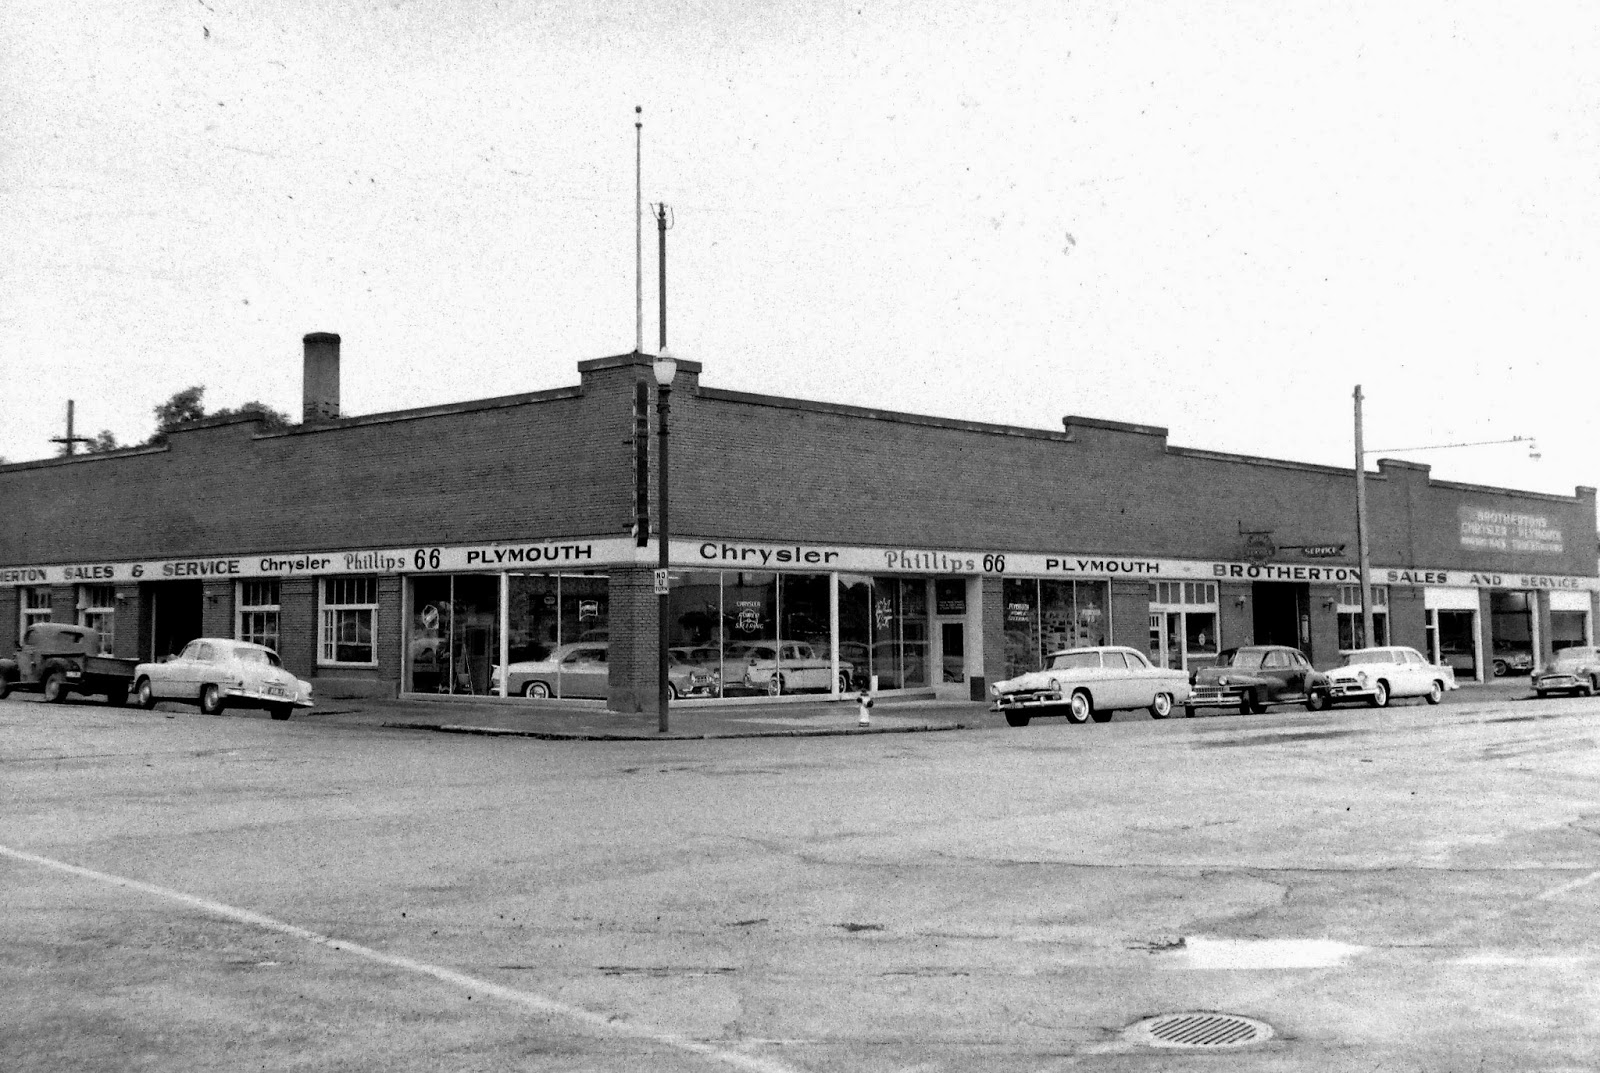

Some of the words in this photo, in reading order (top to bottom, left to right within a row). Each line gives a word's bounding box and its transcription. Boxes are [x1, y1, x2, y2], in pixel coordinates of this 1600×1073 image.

[343, 552, 405, 572] Phillips
[414, 549, 441, 570] 66
[467, 545, 592, 564] PLYMOUTH
[700, 542, 839, 565] Chrysler
[884, 551, 975, 573] Phillips
[983, 554, 1005, 573] 66
[64, 565, 114, 581] SALES
[131, 564, 144, 578] &
[162, 560, 240, 577] SERVICE
[260, 555, 331, 574] Chrysler
[656, 571, 666, 579] NO
[1046, 559, 1159, 574] PLYMOUTH
[1213, 563, 1362, 581] BROTHERTON
[1387, 571, 1448, 584] SALES
[1469, 573, 1502, 586] AND
[1520, 576, 1579, 589] SERVICE
